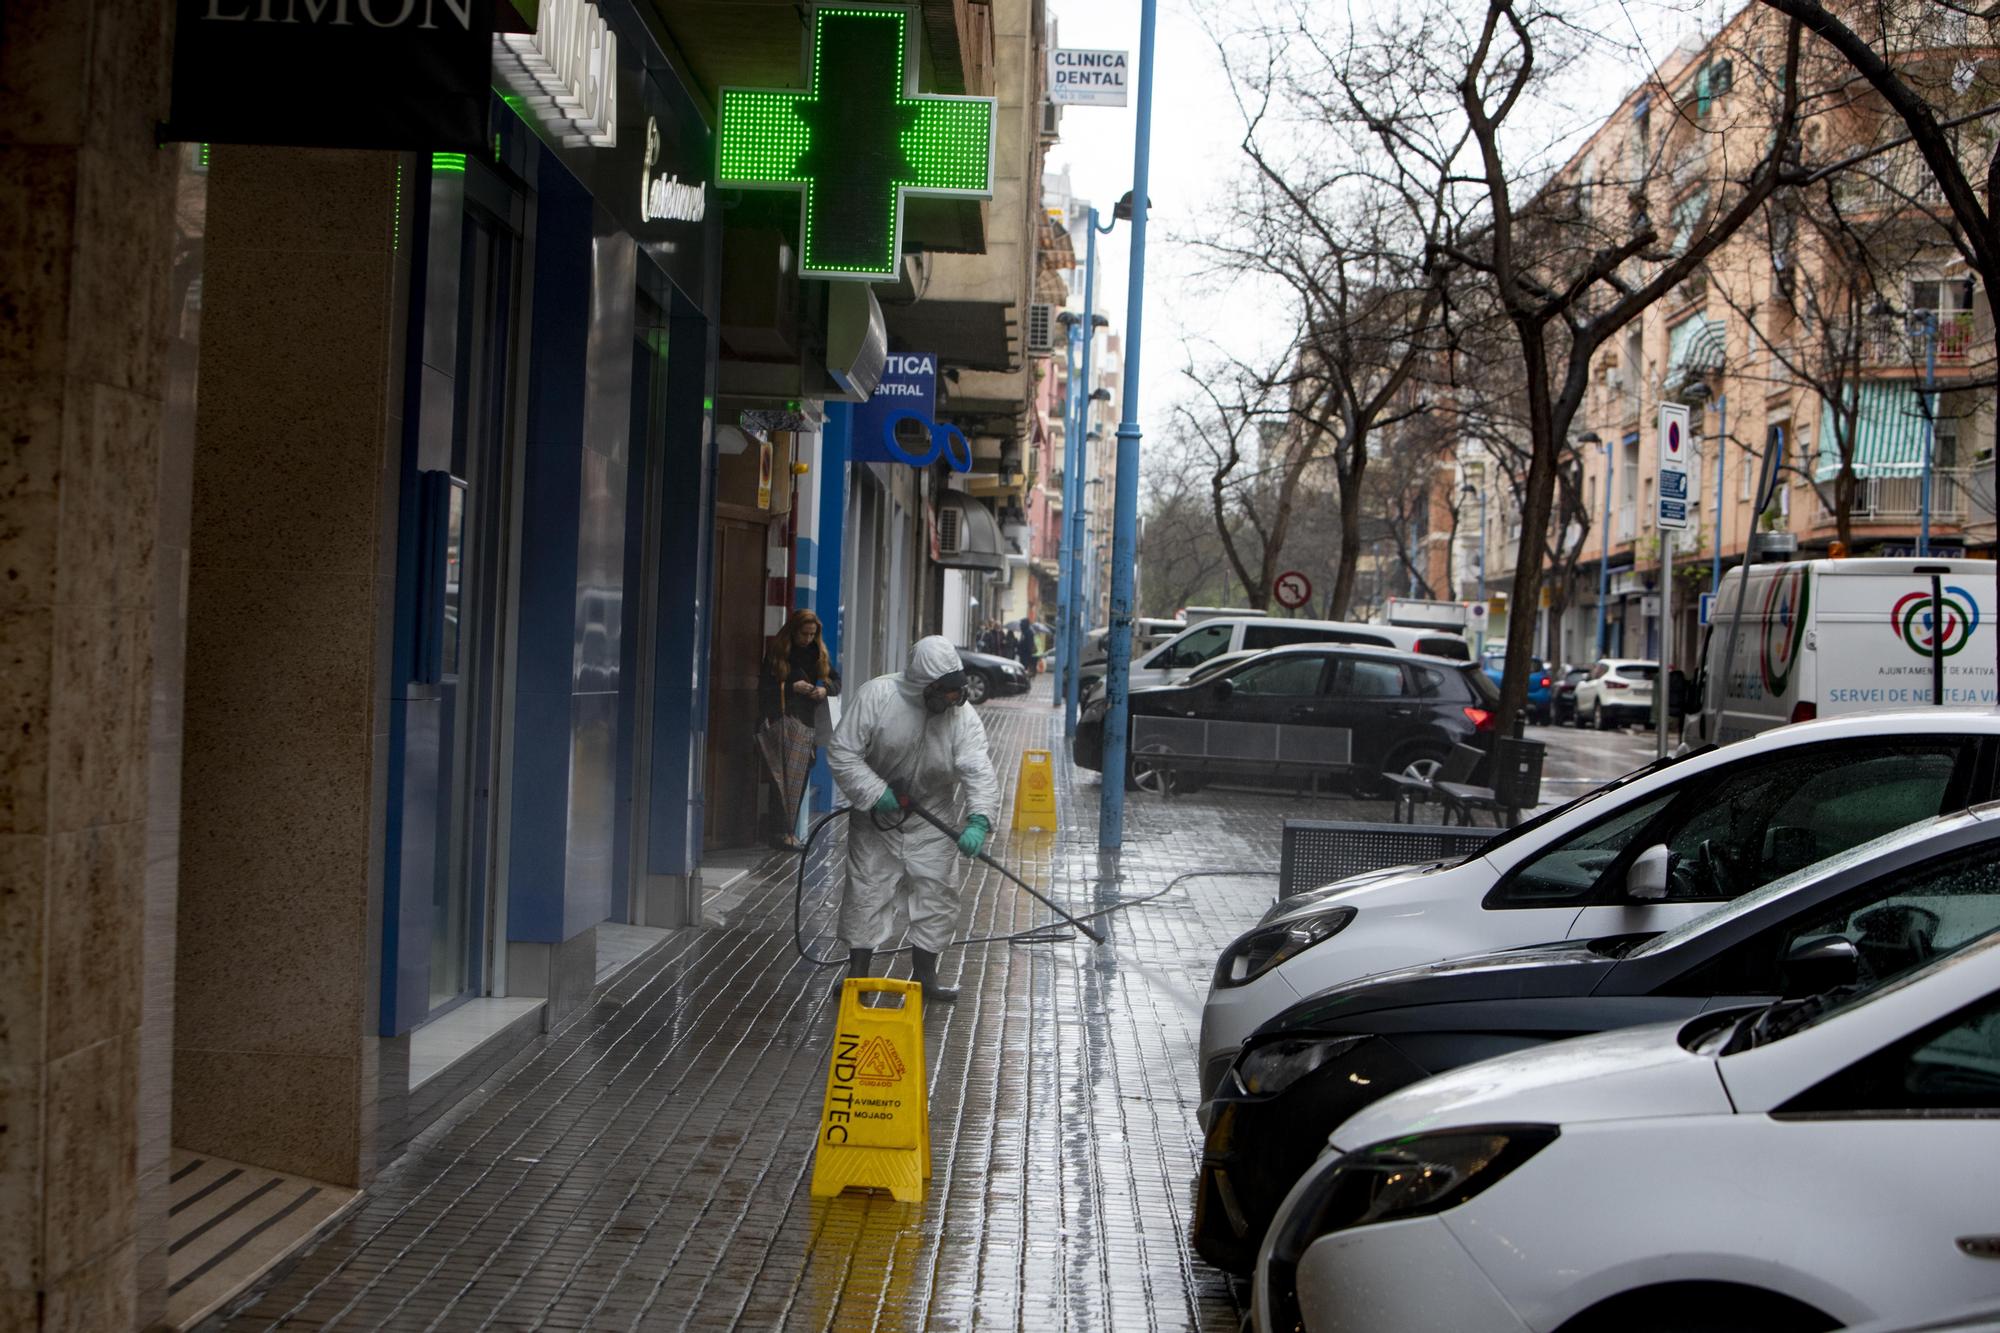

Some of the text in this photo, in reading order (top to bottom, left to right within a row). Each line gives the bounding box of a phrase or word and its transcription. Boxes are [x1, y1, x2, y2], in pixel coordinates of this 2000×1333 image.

[1055, 52, 1125, 68] CLINICA
[1056, 71, 1123, 86] DENTAL
[1829, 688, 1884, 702] SERVEI
[1888, 688, 1908, 702] DE
[1980, 688, 1997, 703] VI
[826, 1033, 860, 1144] INDITEC
[851, 1098, 902, 1108] AVIMENTO
[854, 1111, 894, 1120] MOJADO
